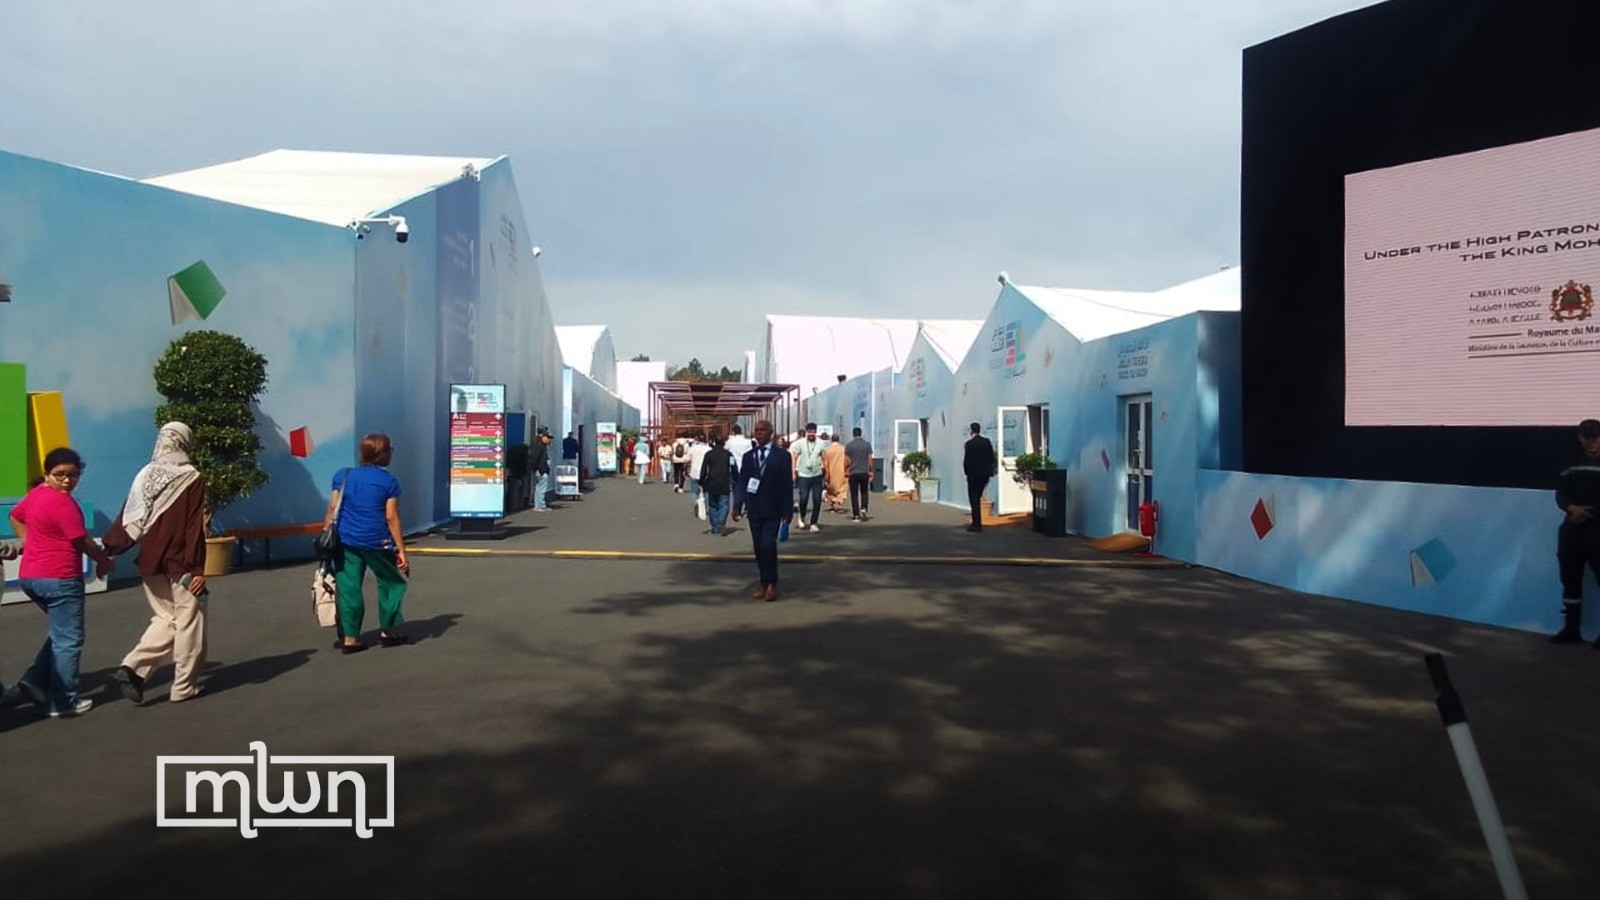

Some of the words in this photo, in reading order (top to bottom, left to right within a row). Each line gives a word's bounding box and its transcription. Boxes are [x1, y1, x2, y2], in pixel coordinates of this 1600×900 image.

[1364, 246, 1421, 260] UNDER
[1426, 240, 1461, 252] THE
[1459, 250, 1497, 262] THE
[1527, 328, 1570, 339] Royaume
[1571, 325, 1584, 336] du
